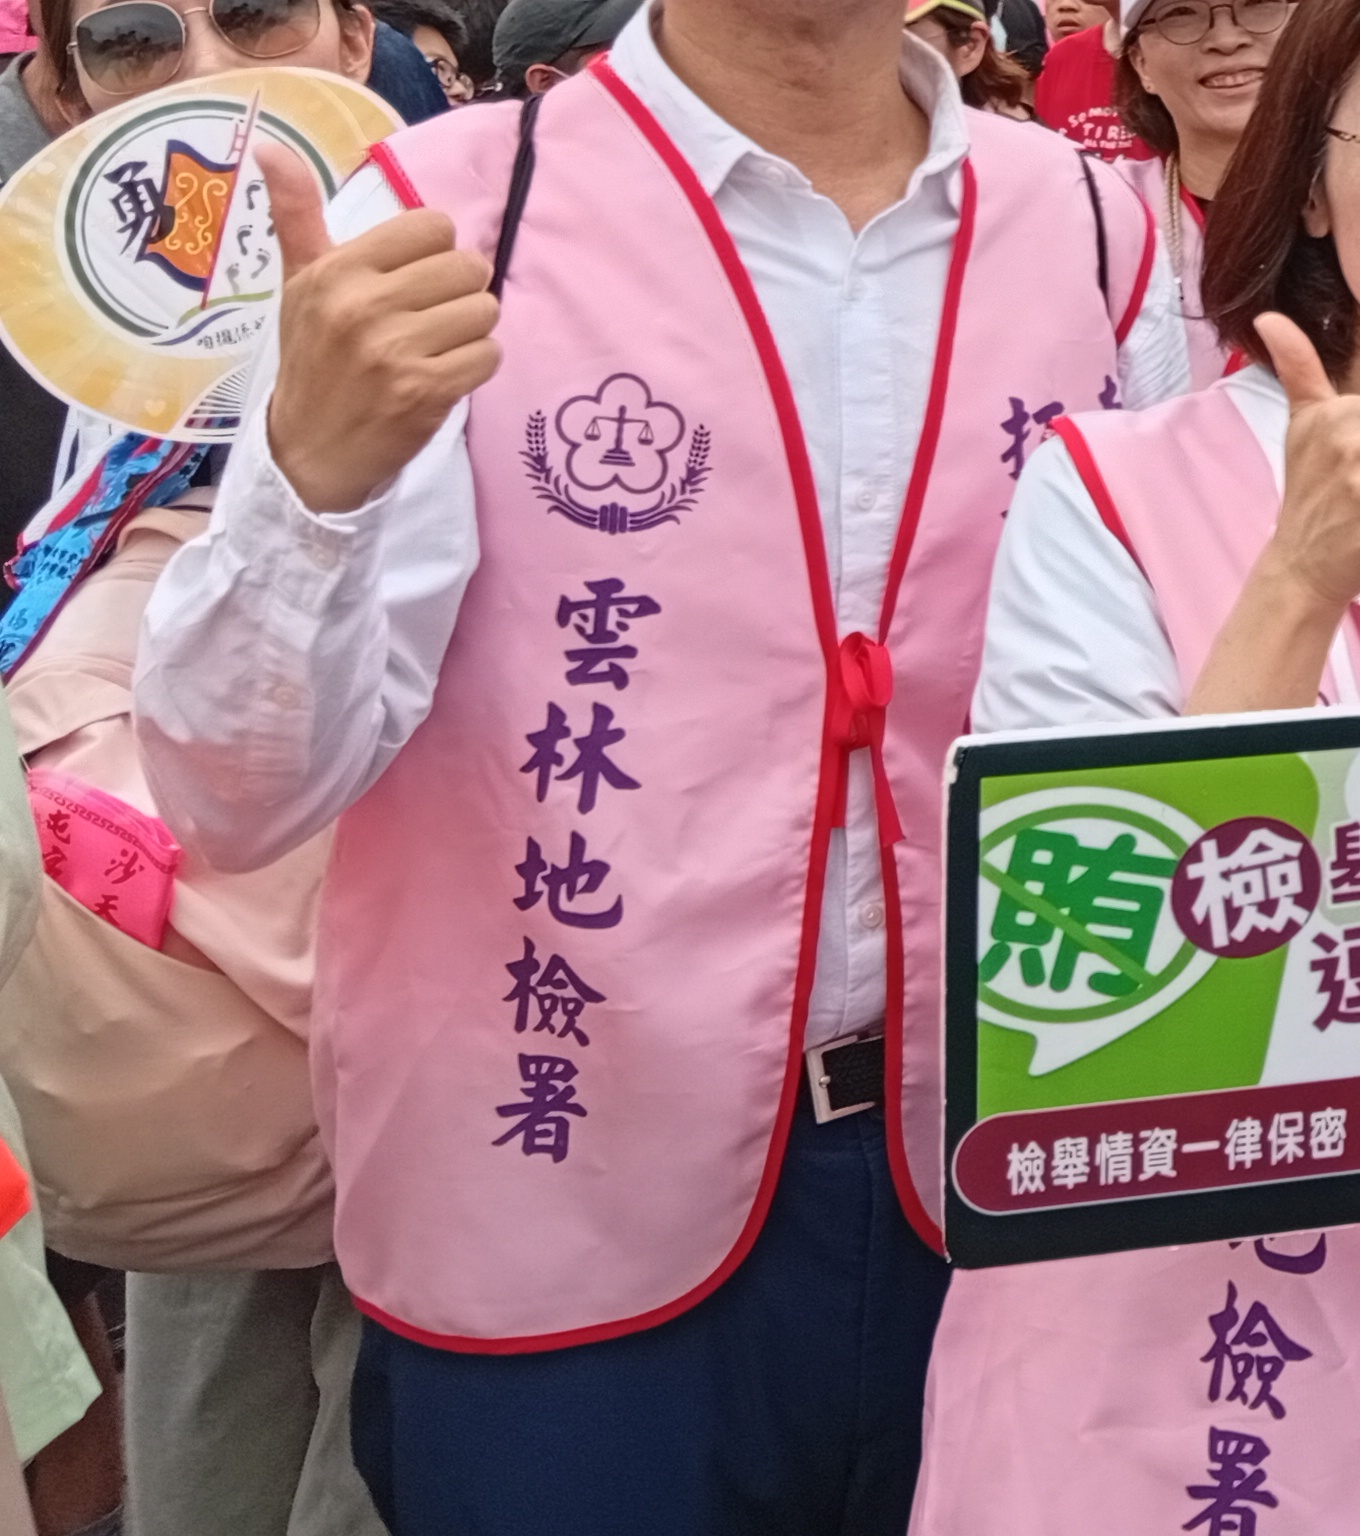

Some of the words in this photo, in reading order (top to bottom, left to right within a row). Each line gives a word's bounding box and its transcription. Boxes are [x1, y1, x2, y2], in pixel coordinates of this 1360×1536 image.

[104, 161, 175, 257] 勇
[491, 576, 662, 1165] 雲林地檢署
[980, 827, 1178, 997] 賄
